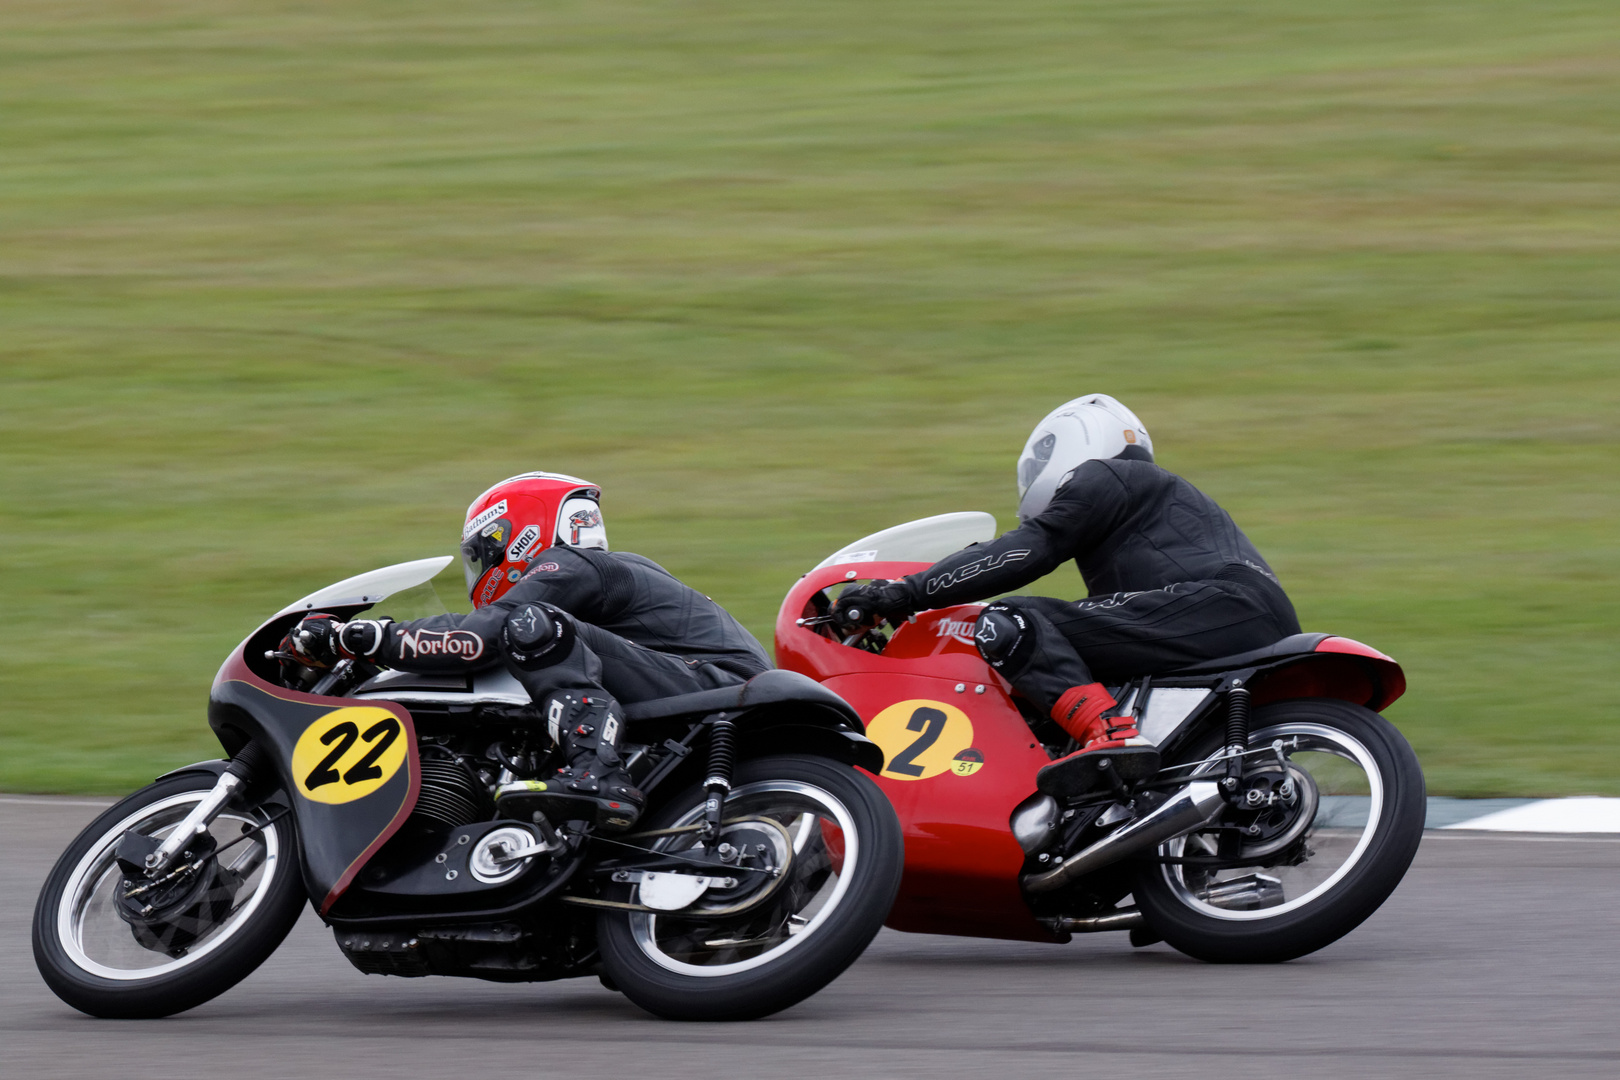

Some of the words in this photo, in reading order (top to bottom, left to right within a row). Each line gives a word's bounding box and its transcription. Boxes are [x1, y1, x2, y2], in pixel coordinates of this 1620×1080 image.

[510, 529, 537, 558] SHOEI
[927, 549, 1031, 594] WOLF
[396, 628, 484, 661] Norton
[304, 717, 401, 791] 22
[886, 706, 948, 777] 2
[957, 762, 974, 773] 51
